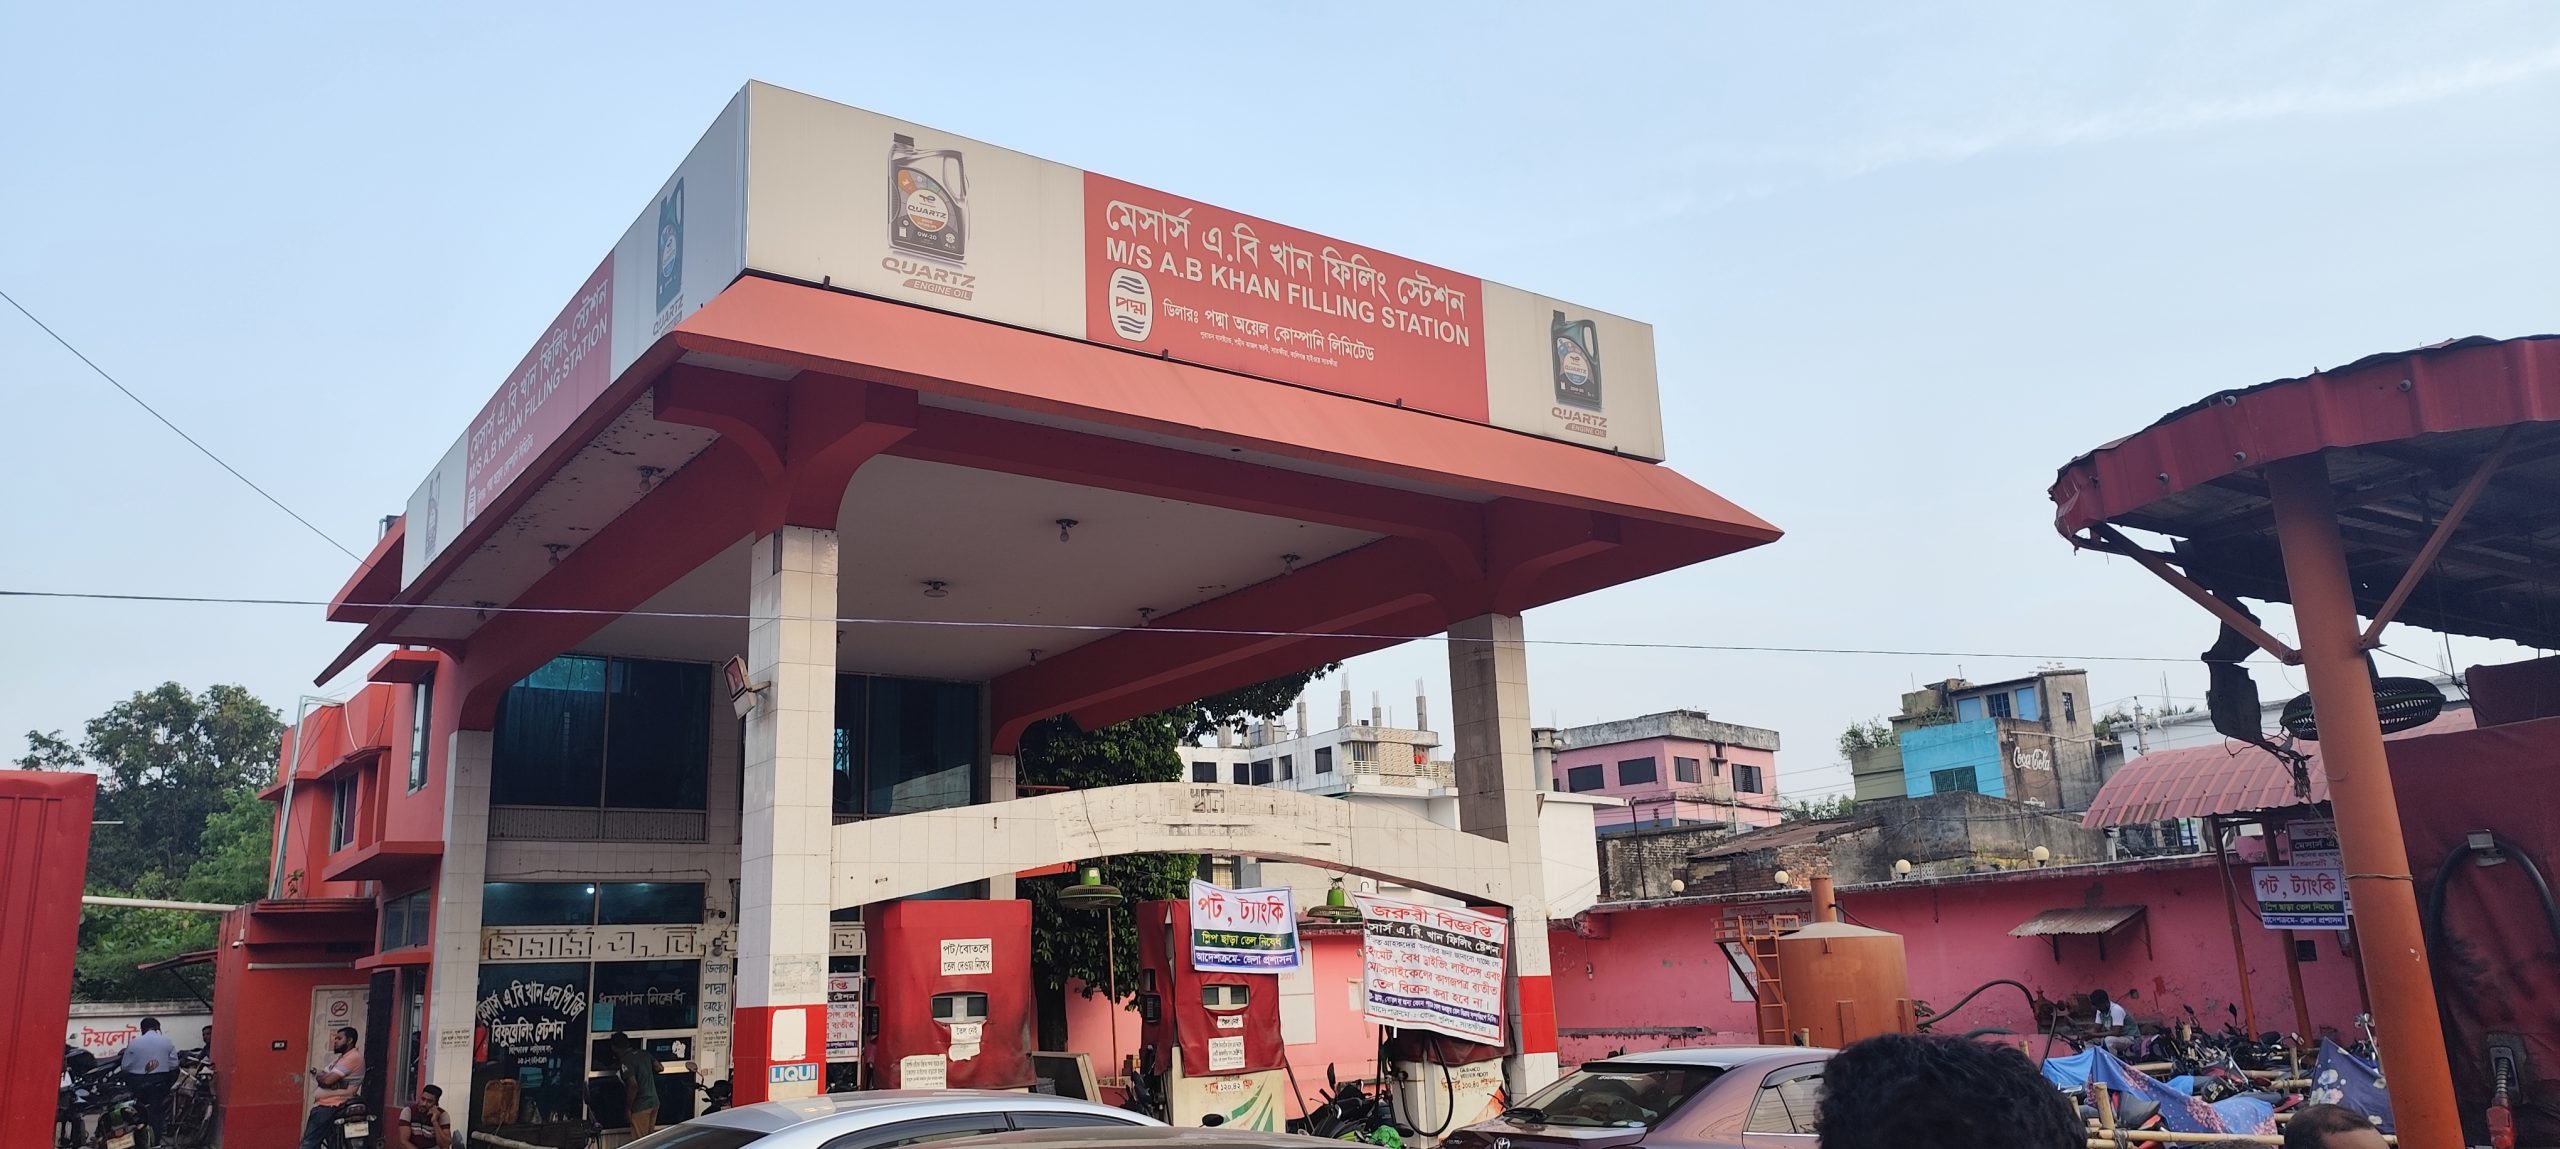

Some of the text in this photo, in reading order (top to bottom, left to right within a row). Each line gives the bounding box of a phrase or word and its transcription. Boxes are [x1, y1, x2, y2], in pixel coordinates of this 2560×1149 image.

[907, 204, 947, 219] QUARTZ
[1106, 199, 1193, 251] মেসার্স
[1269, 240, 1314, 283] খান
[1320, 245, 1391, 304] ফিলিং
[1397, 269, 1467, 321] স্টেশন
[881, 256, 976, 289] QUARTZ
[914, 280, 970, 300] ENGINE OIL
[1106, 236, 1470, 347] M/S A.B KHAN FILLING STATION
[1115, 295, 1147, 317] পদ্মা
[1204, 309, 1229, 330] পদ্মা
[1232, 315, 1269, 339] অয়েল
[1274, 326, 1324, 352] কোম্পানি
[1327, 332, 1375, 361] লিমিটেড
[500, 408, 523, 448] KHAN
[524, 375, 560, 423] FILLING
[560, 312, 608, 383] STATION
[470, 401, 497, 461] মেসার্স
[520, 363, 538, 399] খান
[540, 328, 570, 381] ফিলিং
[1551, 406, 1608, 428] QUARTZ
[2290, 872, 2336, 896] ট্যাংকি
[1235, 895, 1285, 926] ট্যাংকি
[1372, 905, 1493, 938] জরুরী বিজ্ঞপ্তি
[942, 942, 990, 957] পট/বোতলে
[1220, 934, 1239, 946] ছাড়া
[1240, 936, 1257, 946] তেল
[1258, 934, 1282, 947] নিষেধ
[1426, 930, 1444, 942] খান
[1446, 932, 1472, 951] ফিলিং
[943, 960, 956, 972] তেল
[1243, 954, 1261, 965] জেলা
[1262, 954, 1294, 966] প্রশাসন
[1402, 950, 1420, 962] বৈধ
[1484, 970, 1500, 982] এবং
[704, 982, 727, 995] পদ্মা
[1368, 962, 1432, 980] মোরসাইকেলের
[1472, 982, 1499, 996] ব্যতীত
[477, 989, 504, 1026] মেসার্স
[525, 980, 544, 1004] খান
[646, 986, 686, 1006] নিষেধ
[1432, 988, 1448, 1000] করা
[1452, 992, 1470, 1006] হবে
[771, 1064, 817, 1083] LIQUI
